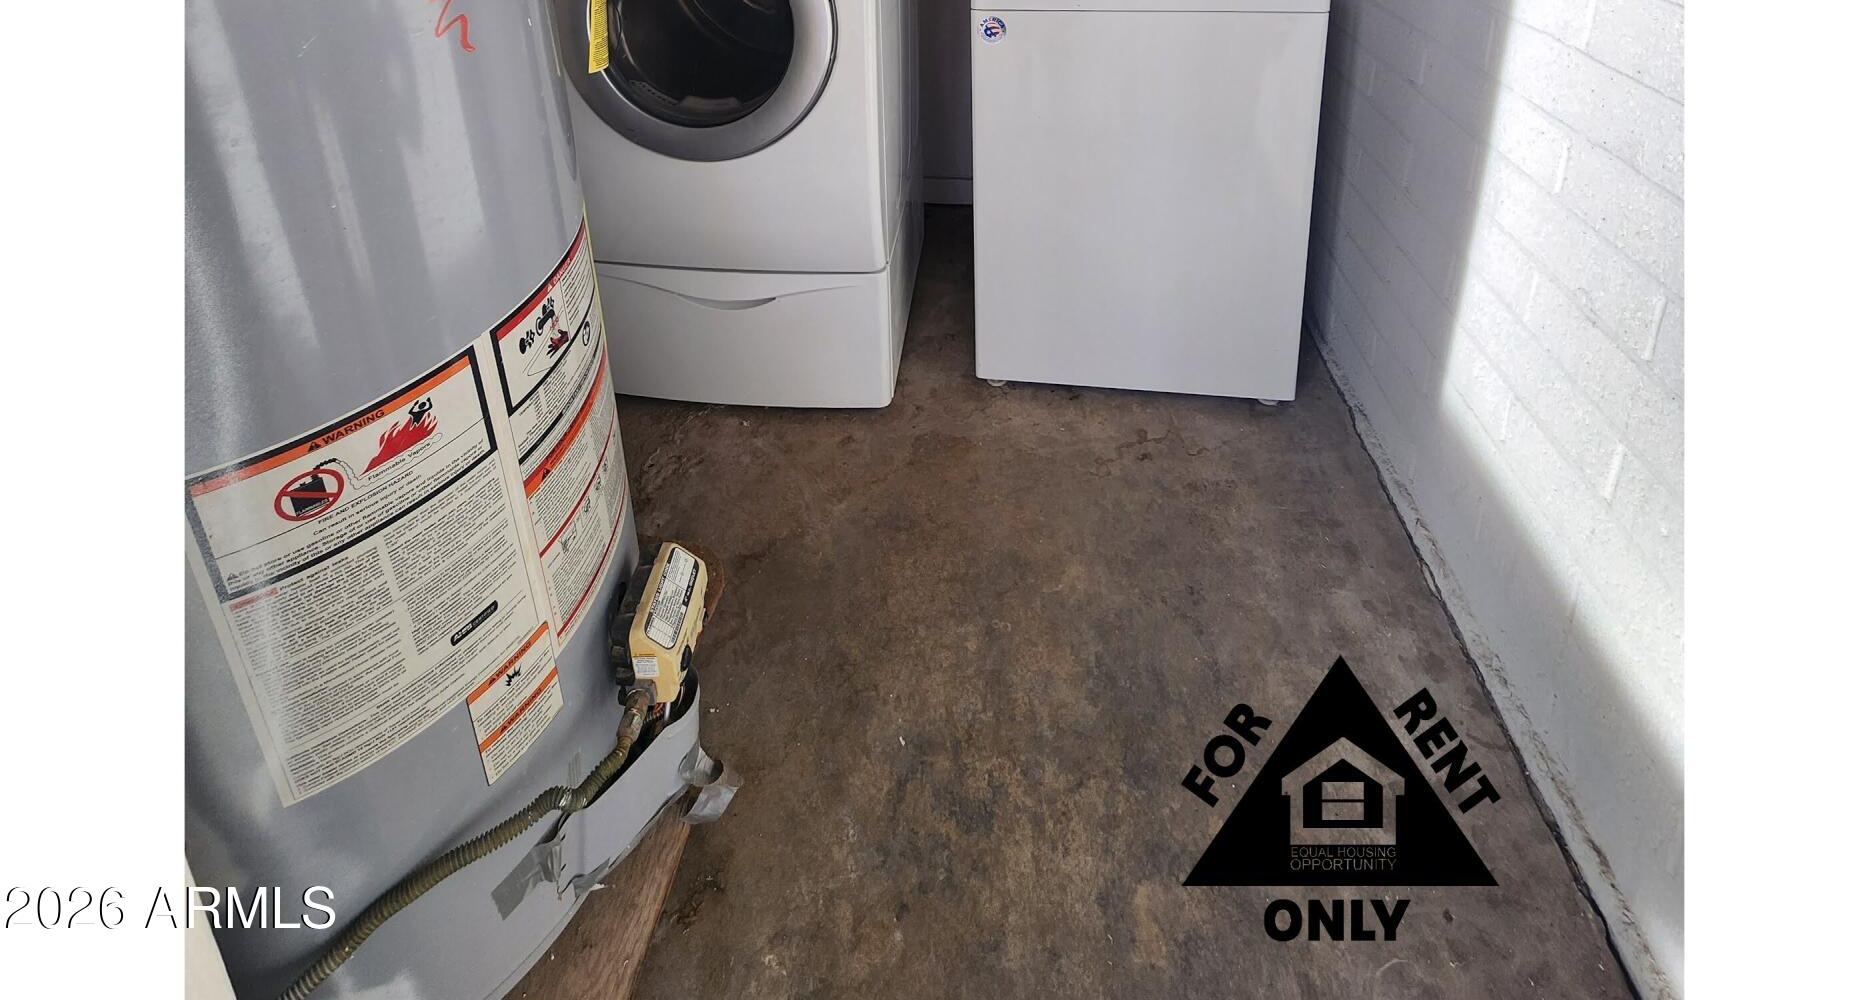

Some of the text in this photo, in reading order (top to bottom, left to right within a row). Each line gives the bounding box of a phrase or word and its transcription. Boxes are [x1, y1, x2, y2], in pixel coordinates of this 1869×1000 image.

[322, 409, 385, 445] WARNING
[368, 442, 431, 481] Flammable Vapors
[313, 527, 327, 536] Can
[328, 518, 347, 528] result
[356, 500, 379, 515] serious
[380, 490, 397, 501] injury
[318, 470, 414, 524] FIRE AND EXPLOSION HAZARD
[362, 501, 394, 520] flammable
[279, 578, 304, 590] Protect
[306, 565, 330, 580] against
[495, 641, 531, 678] WARNING
[507, 688, 543, 726] WARNING
